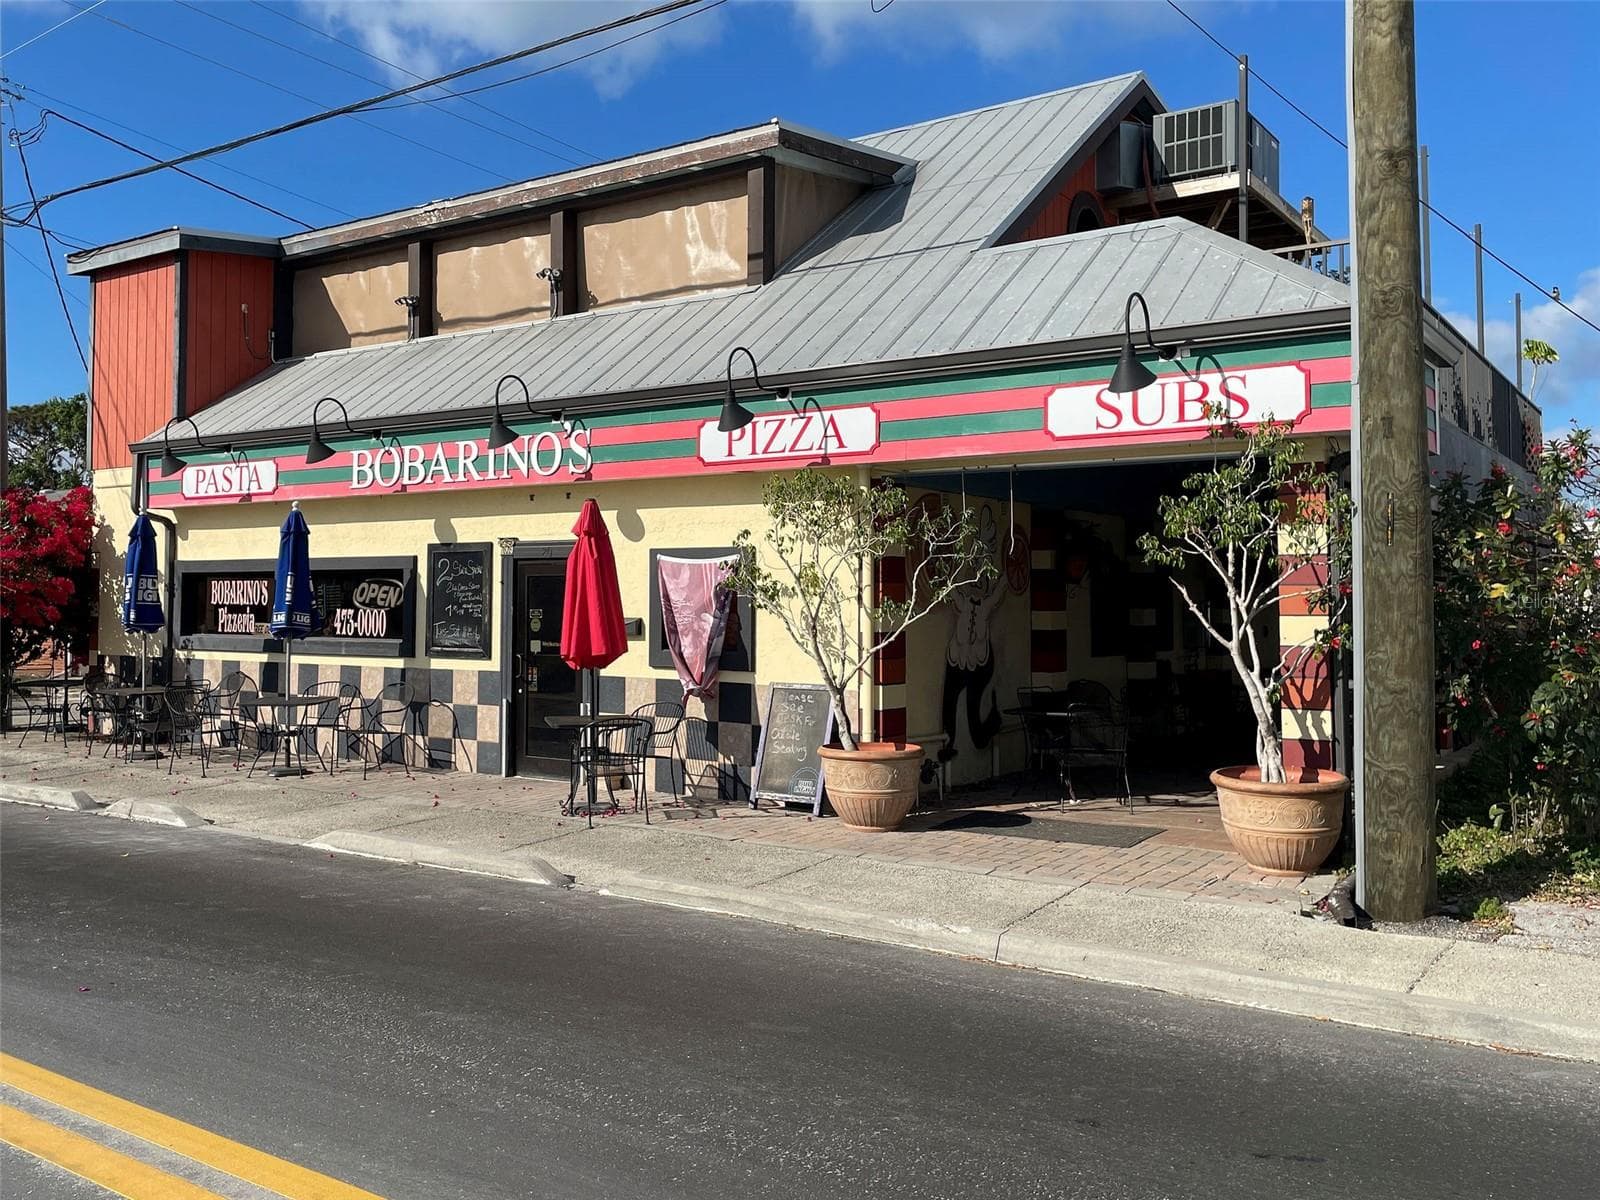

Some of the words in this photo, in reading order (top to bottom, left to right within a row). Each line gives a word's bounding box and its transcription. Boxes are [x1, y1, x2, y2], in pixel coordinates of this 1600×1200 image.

[1095, 374, 1250, 431] SUBS
[724, 413, 848, 457] PIZZA
[349, 421, 593, 489] BOBARINO'S
[194, 465, 263, 494] PASTA
[210, 580, 269, 606] BOBARINO'S
[356, 582, 401, 608] OPEN
[217, 606, 255, 633] Pizzeria
[333, 608, 387, 637] 473-0000
